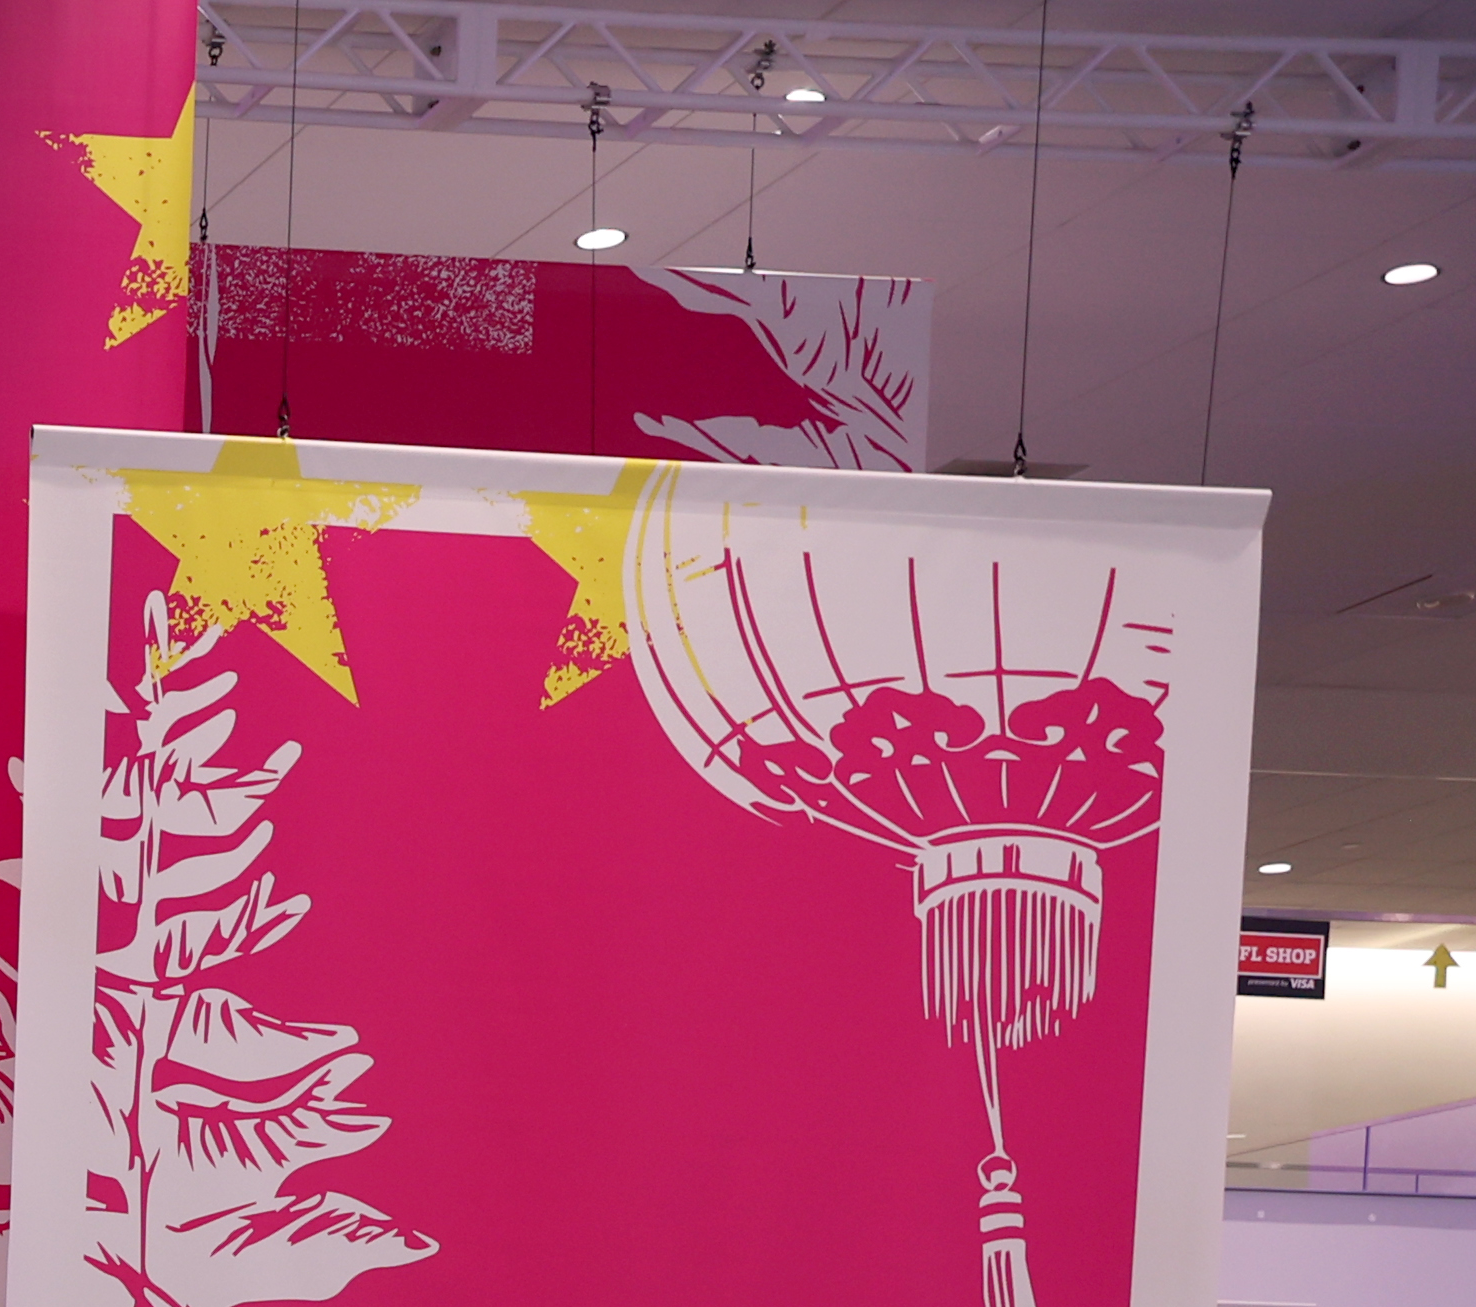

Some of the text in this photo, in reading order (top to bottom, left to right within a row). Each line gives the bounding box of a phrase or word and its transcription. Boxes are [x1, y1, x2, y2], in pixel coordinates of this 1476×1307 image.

[1238, 946, 1316, 965] FL SHOP
[1290, 978, 1316, 990] VISA
